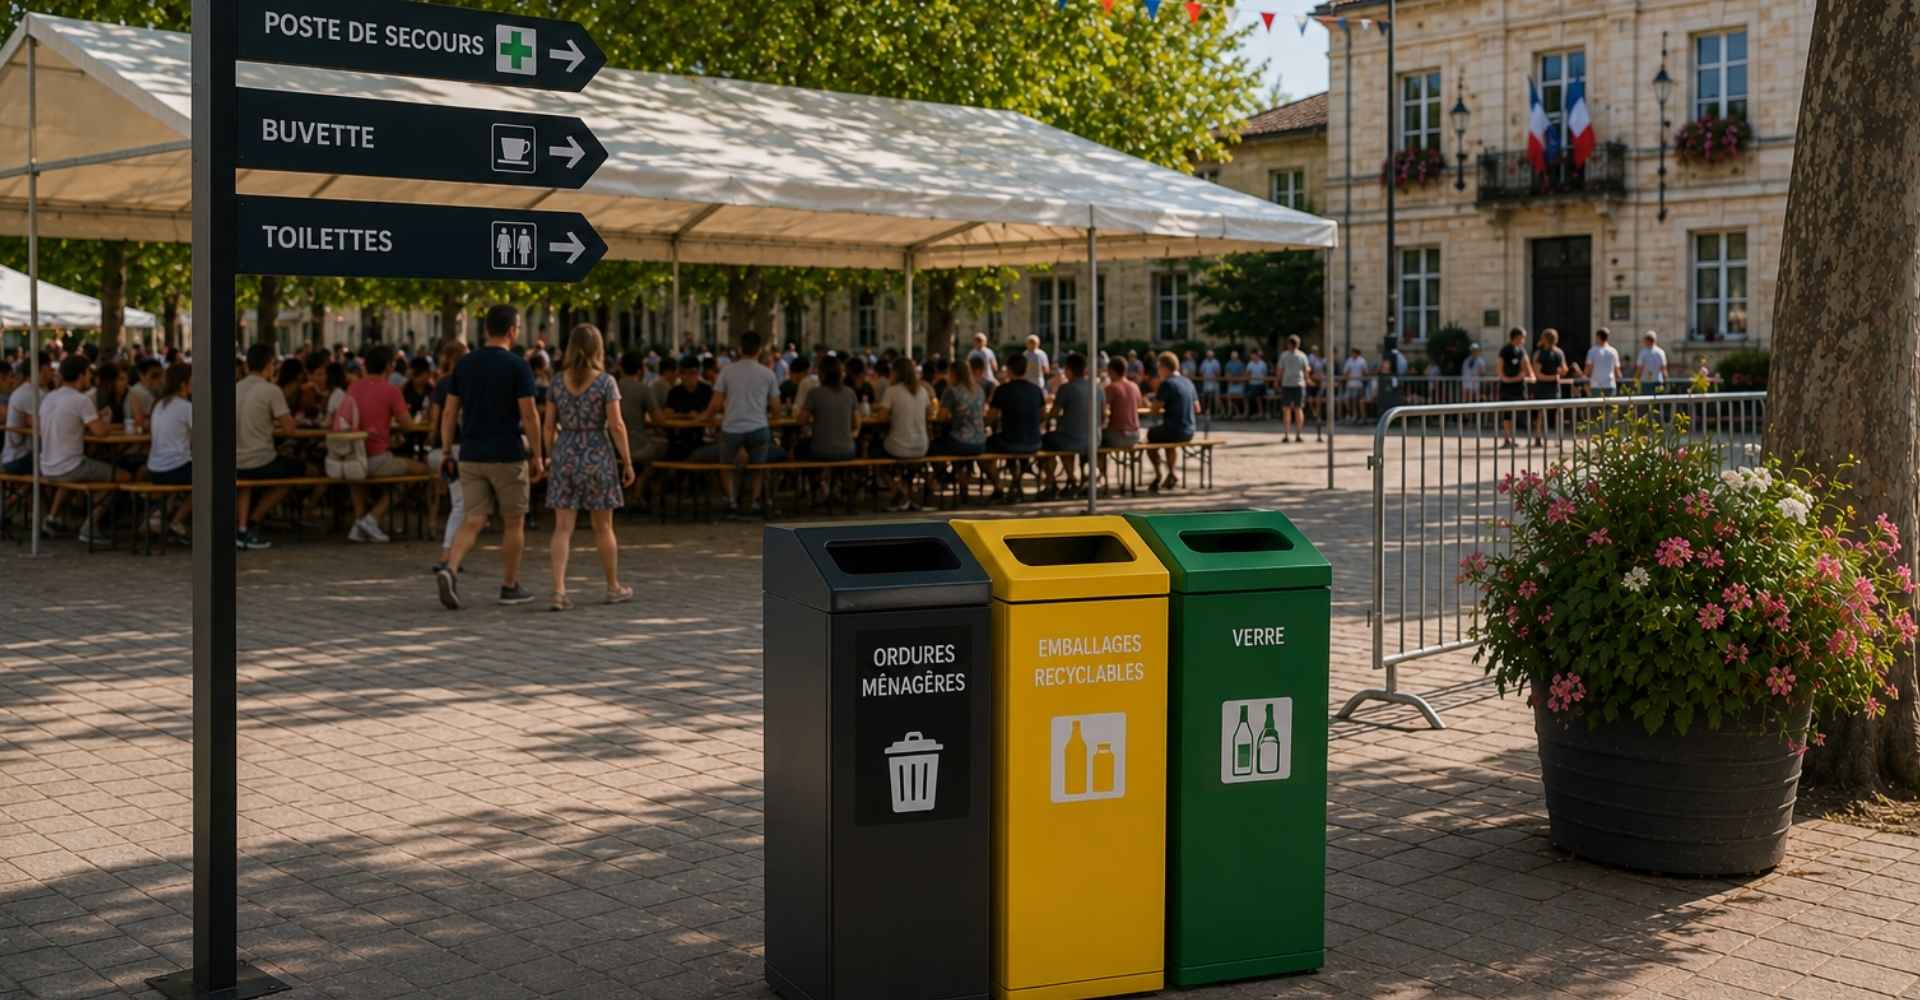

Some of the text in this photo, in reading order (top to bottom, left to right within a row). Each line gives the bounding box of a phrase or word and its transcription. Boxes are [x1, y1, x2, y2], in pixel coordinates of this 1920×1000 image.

[264, 11, 484, 56] POSTE DE SECOURS
[262, 118, 375, 149] BUVETTE
[262, 225, 393, 252] TOILETTES
[1038, 634, 1142, 657] EMBALLAGES
[1232, 626, 1285, 647] VERRE
[873, 644, 956, 667] ORDURES
[1034, 662, 1144, 687] RECYCLABLES
